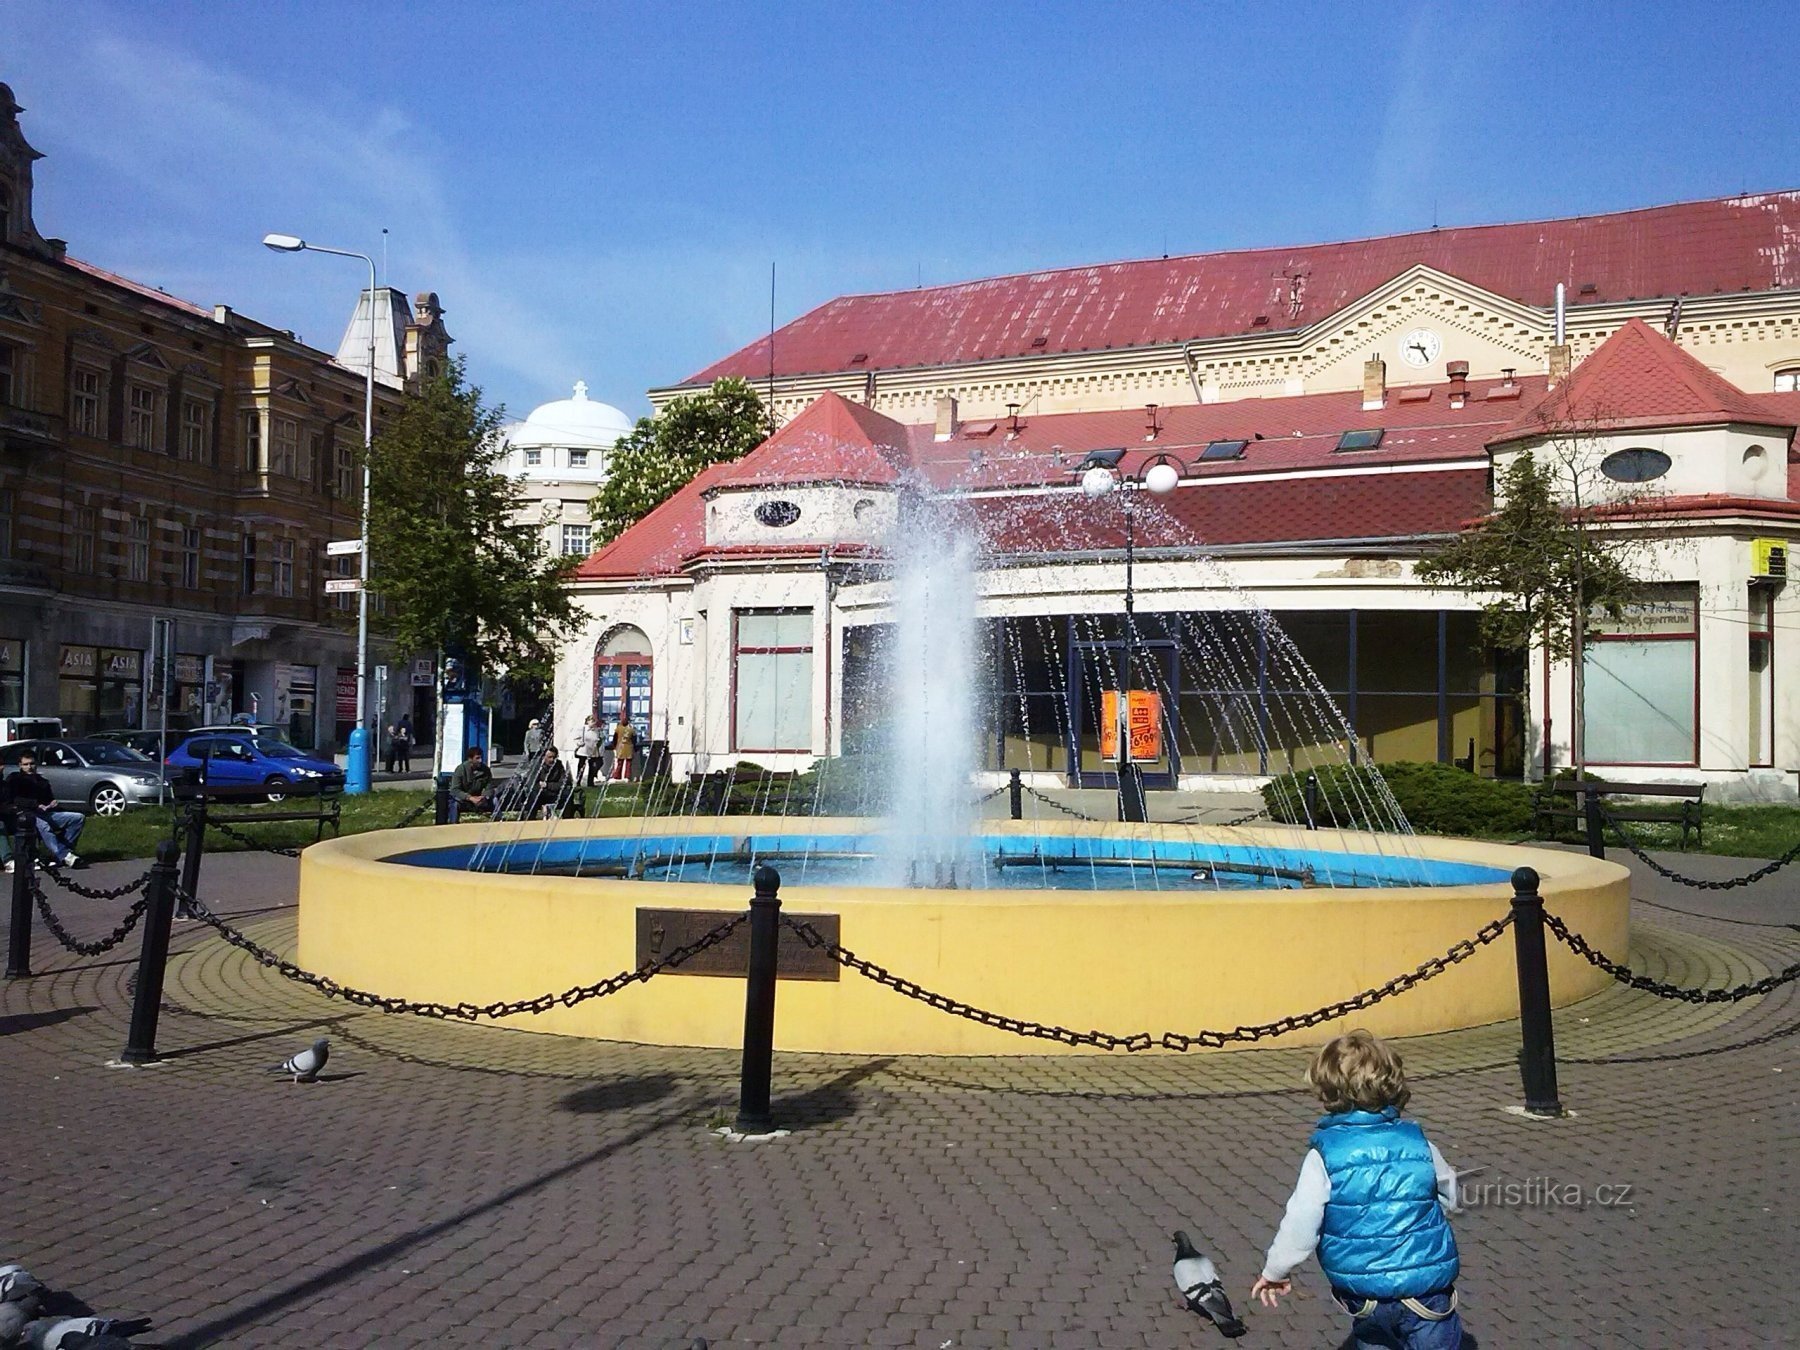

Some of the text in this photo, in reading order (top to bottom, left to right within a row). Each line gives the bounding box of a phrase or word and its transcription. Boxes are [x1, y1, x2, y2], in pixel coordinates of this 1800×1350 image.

[1643, 615, 1690, 624] CENTRUM
[64, 653, 92, 666] ASIA
[111, 655, 137, 669] ASIA
